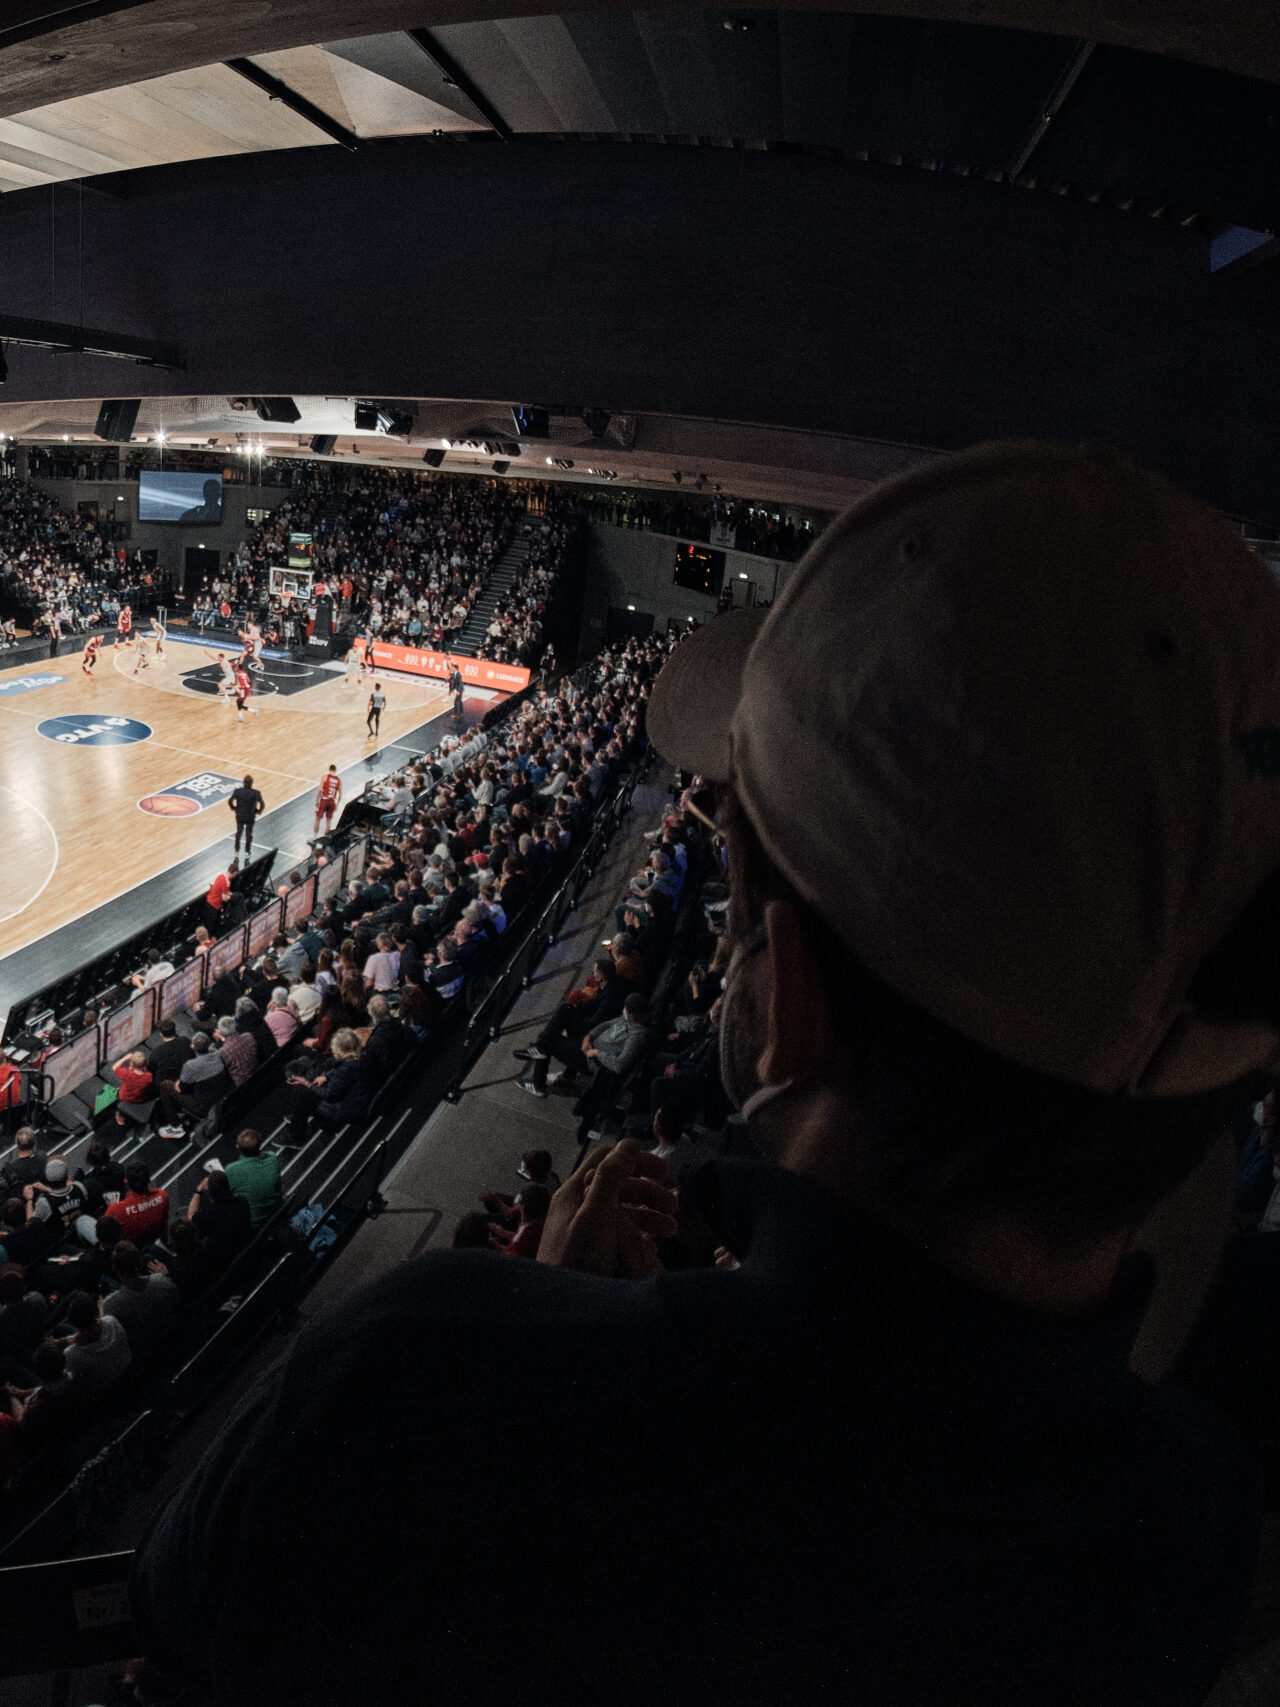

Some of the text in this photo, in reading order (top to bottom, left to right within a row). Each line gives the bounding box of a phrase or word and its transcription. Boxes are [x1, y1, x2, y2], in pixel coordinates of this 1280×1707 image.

[55, 723, 114, 743] VTG
[176, 773, 222, 792] BBL
[125, 1206, 138, 1216] FC
